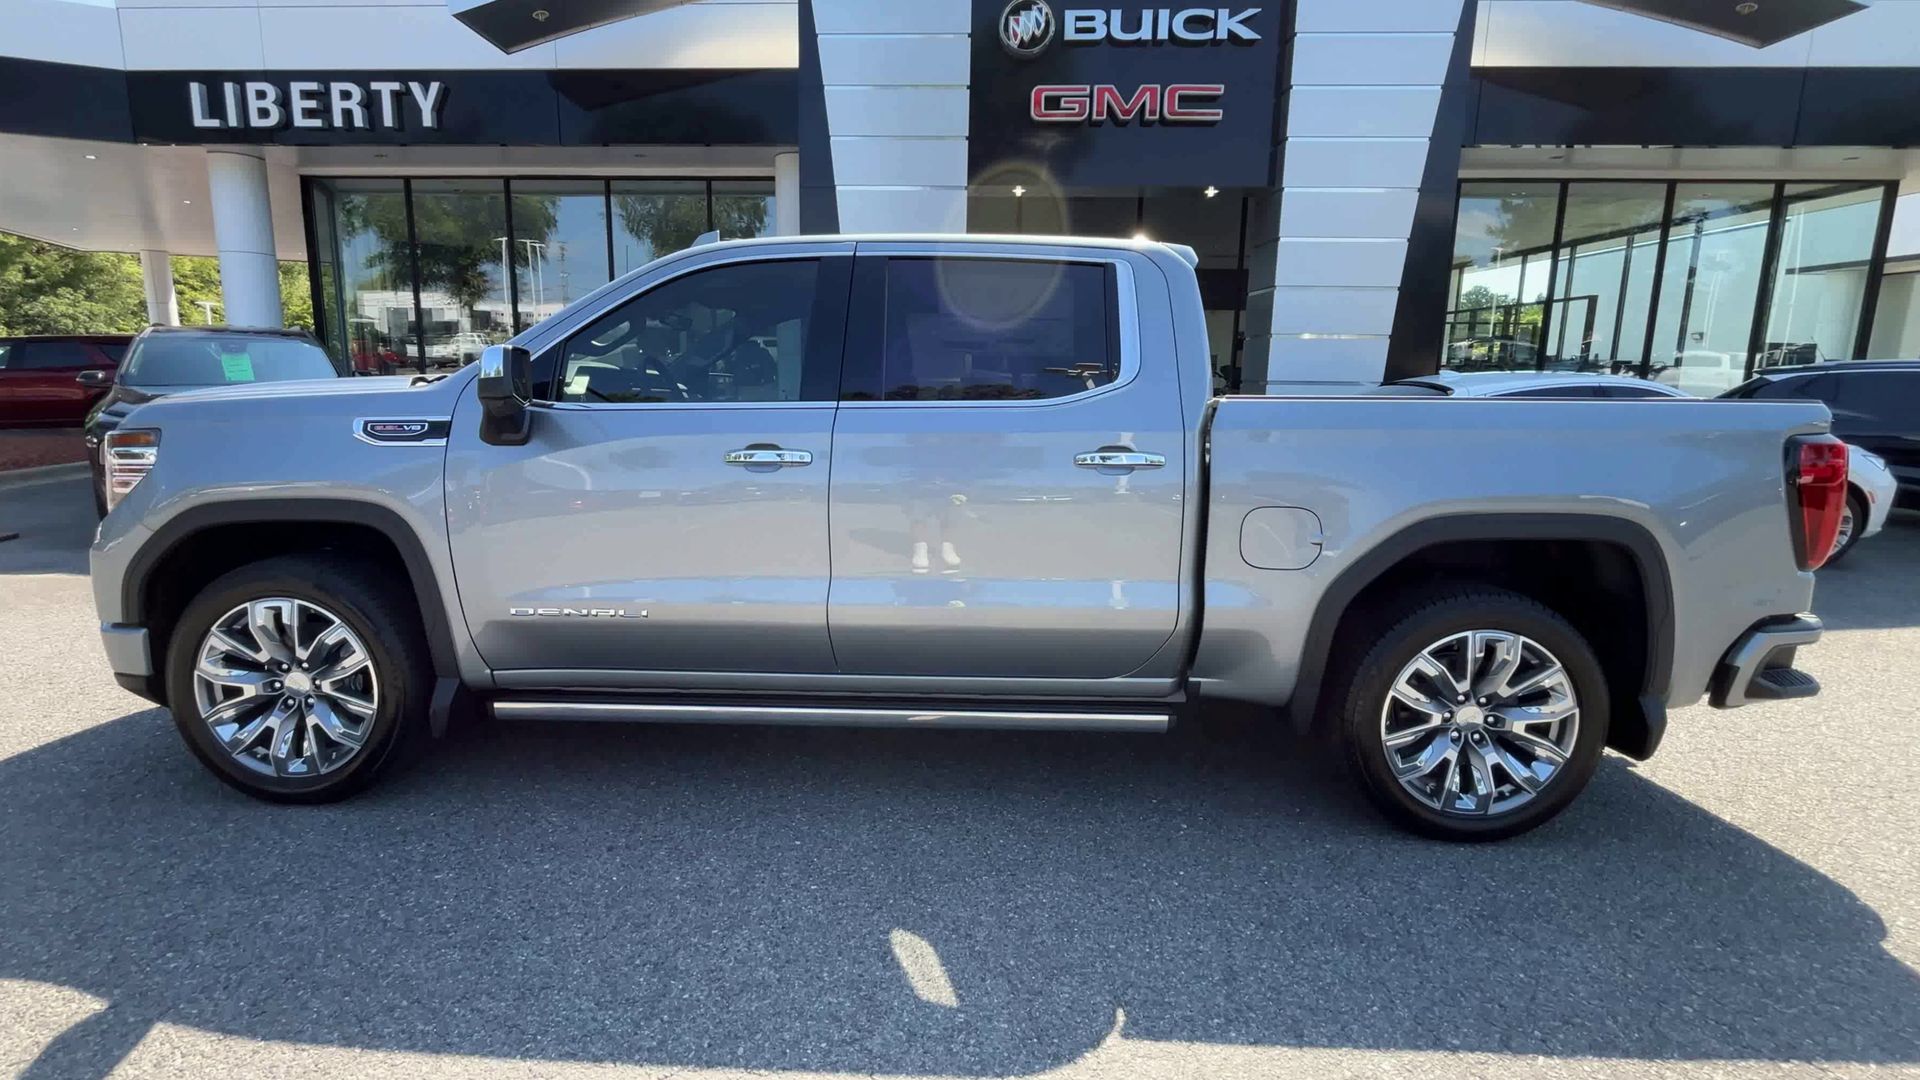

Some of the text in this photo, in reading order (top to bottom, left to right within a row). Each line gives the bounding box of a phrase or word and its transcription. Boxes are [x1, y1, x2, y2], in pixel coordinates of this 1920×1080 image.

[1063, 8, 1263, 41] BUICK
[188, 81, 443, 130] LIBERTY
[1030, 84, 1225, 122] GMC
[509, 607, 649, 618] DENALI
